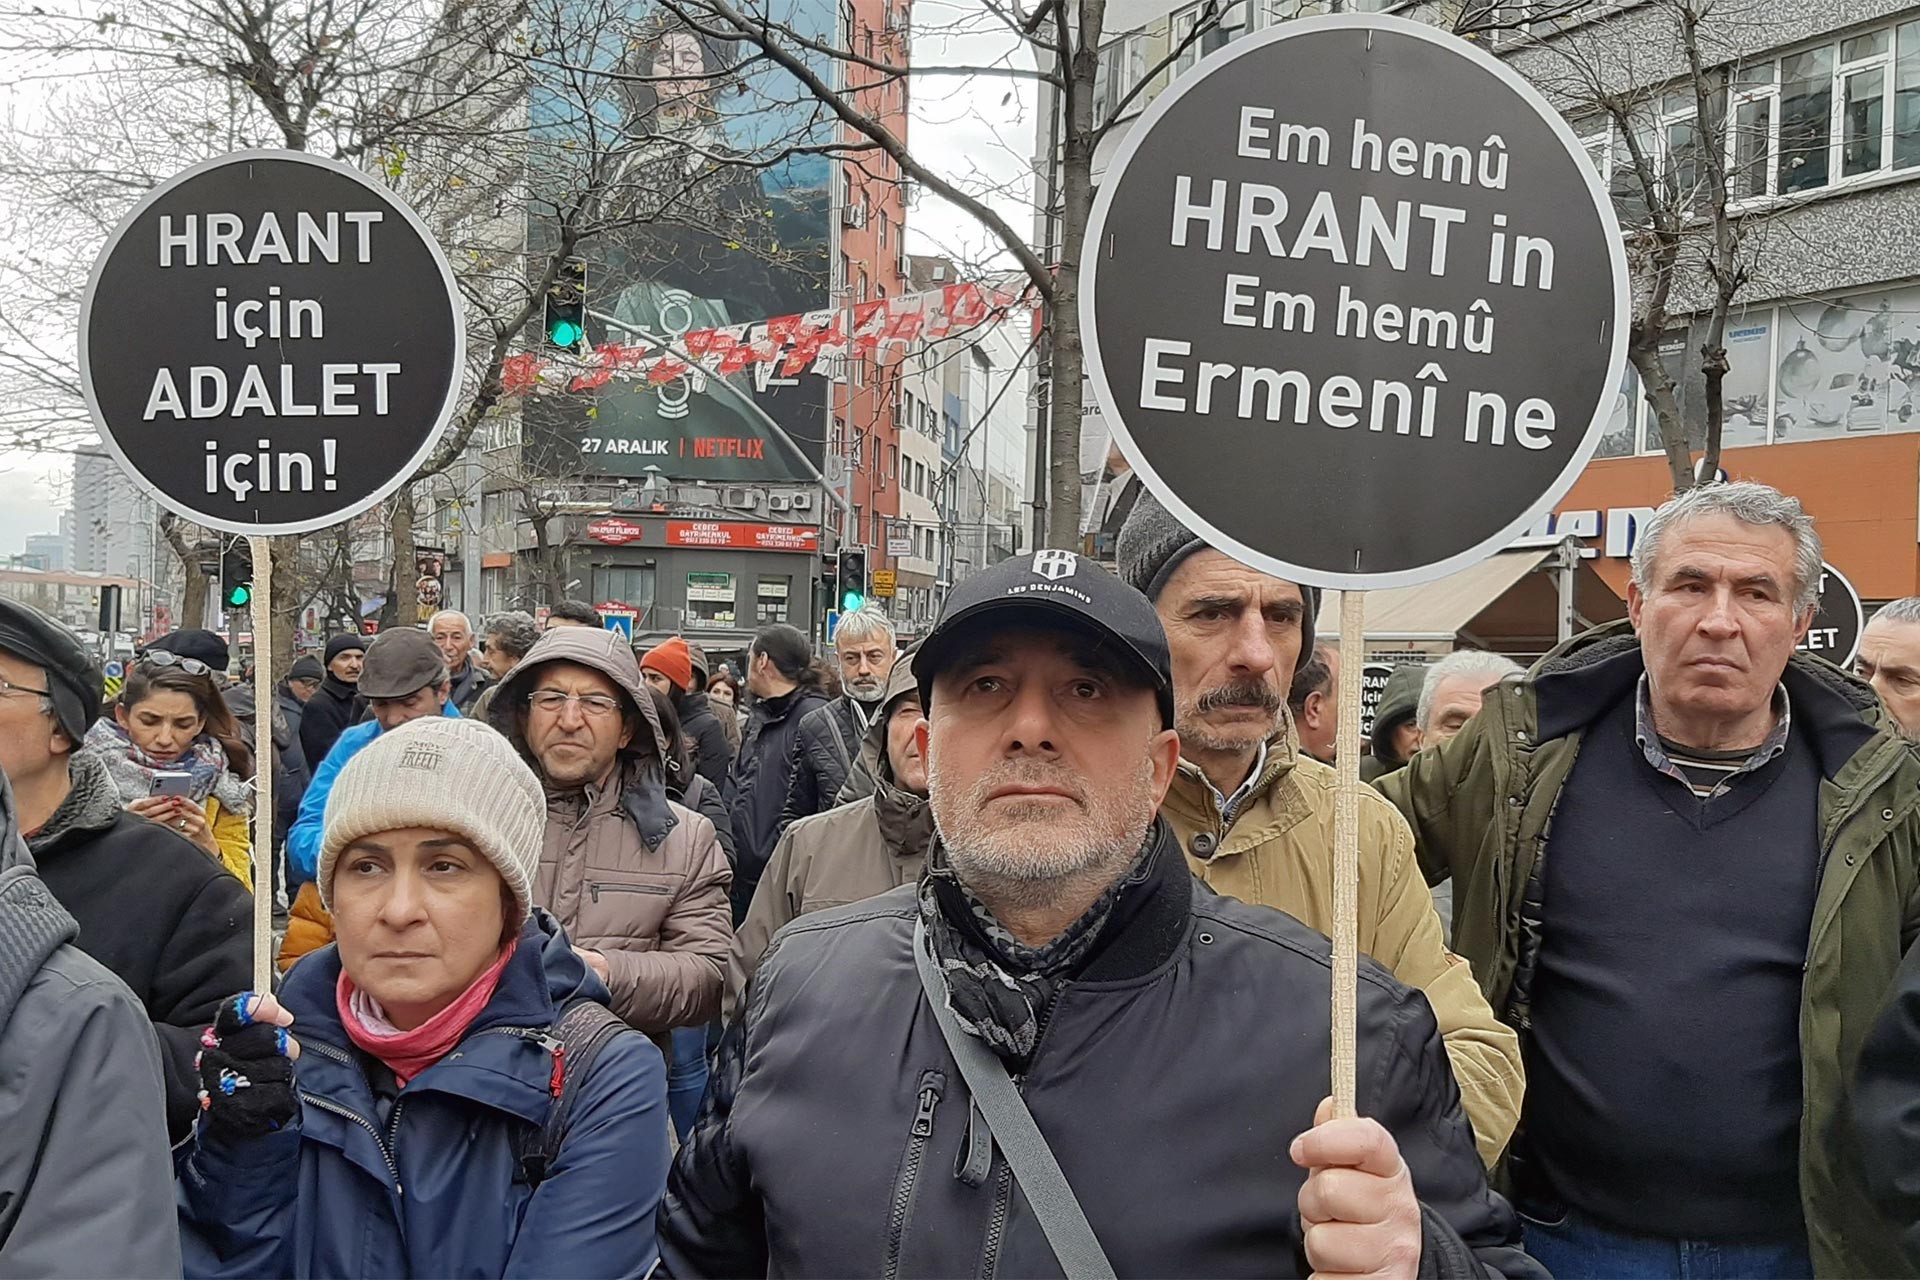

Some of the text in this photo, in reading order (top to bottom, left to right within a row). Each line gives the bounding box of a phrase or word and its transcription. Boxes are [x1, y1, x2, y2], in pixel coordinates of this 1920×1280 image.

[1237, 104, 1509, 191] Em hemû
[159, 210, 383, 267] HRANT
[1170, 174, 1556, 292] HRANT in
[214, 286, 326, 348] için
[1221, 272, 1496, 355] Em hemû
[142, 362, 402, 422] ADALET
[1138, 336, 1557, 451] Ermenî ne
[204, 438, 338, 503] için!
[581, 437, 765, 460] 27 ARALIK NETFLIX
[1030, 583, 1092, 604] BENJAMINS
